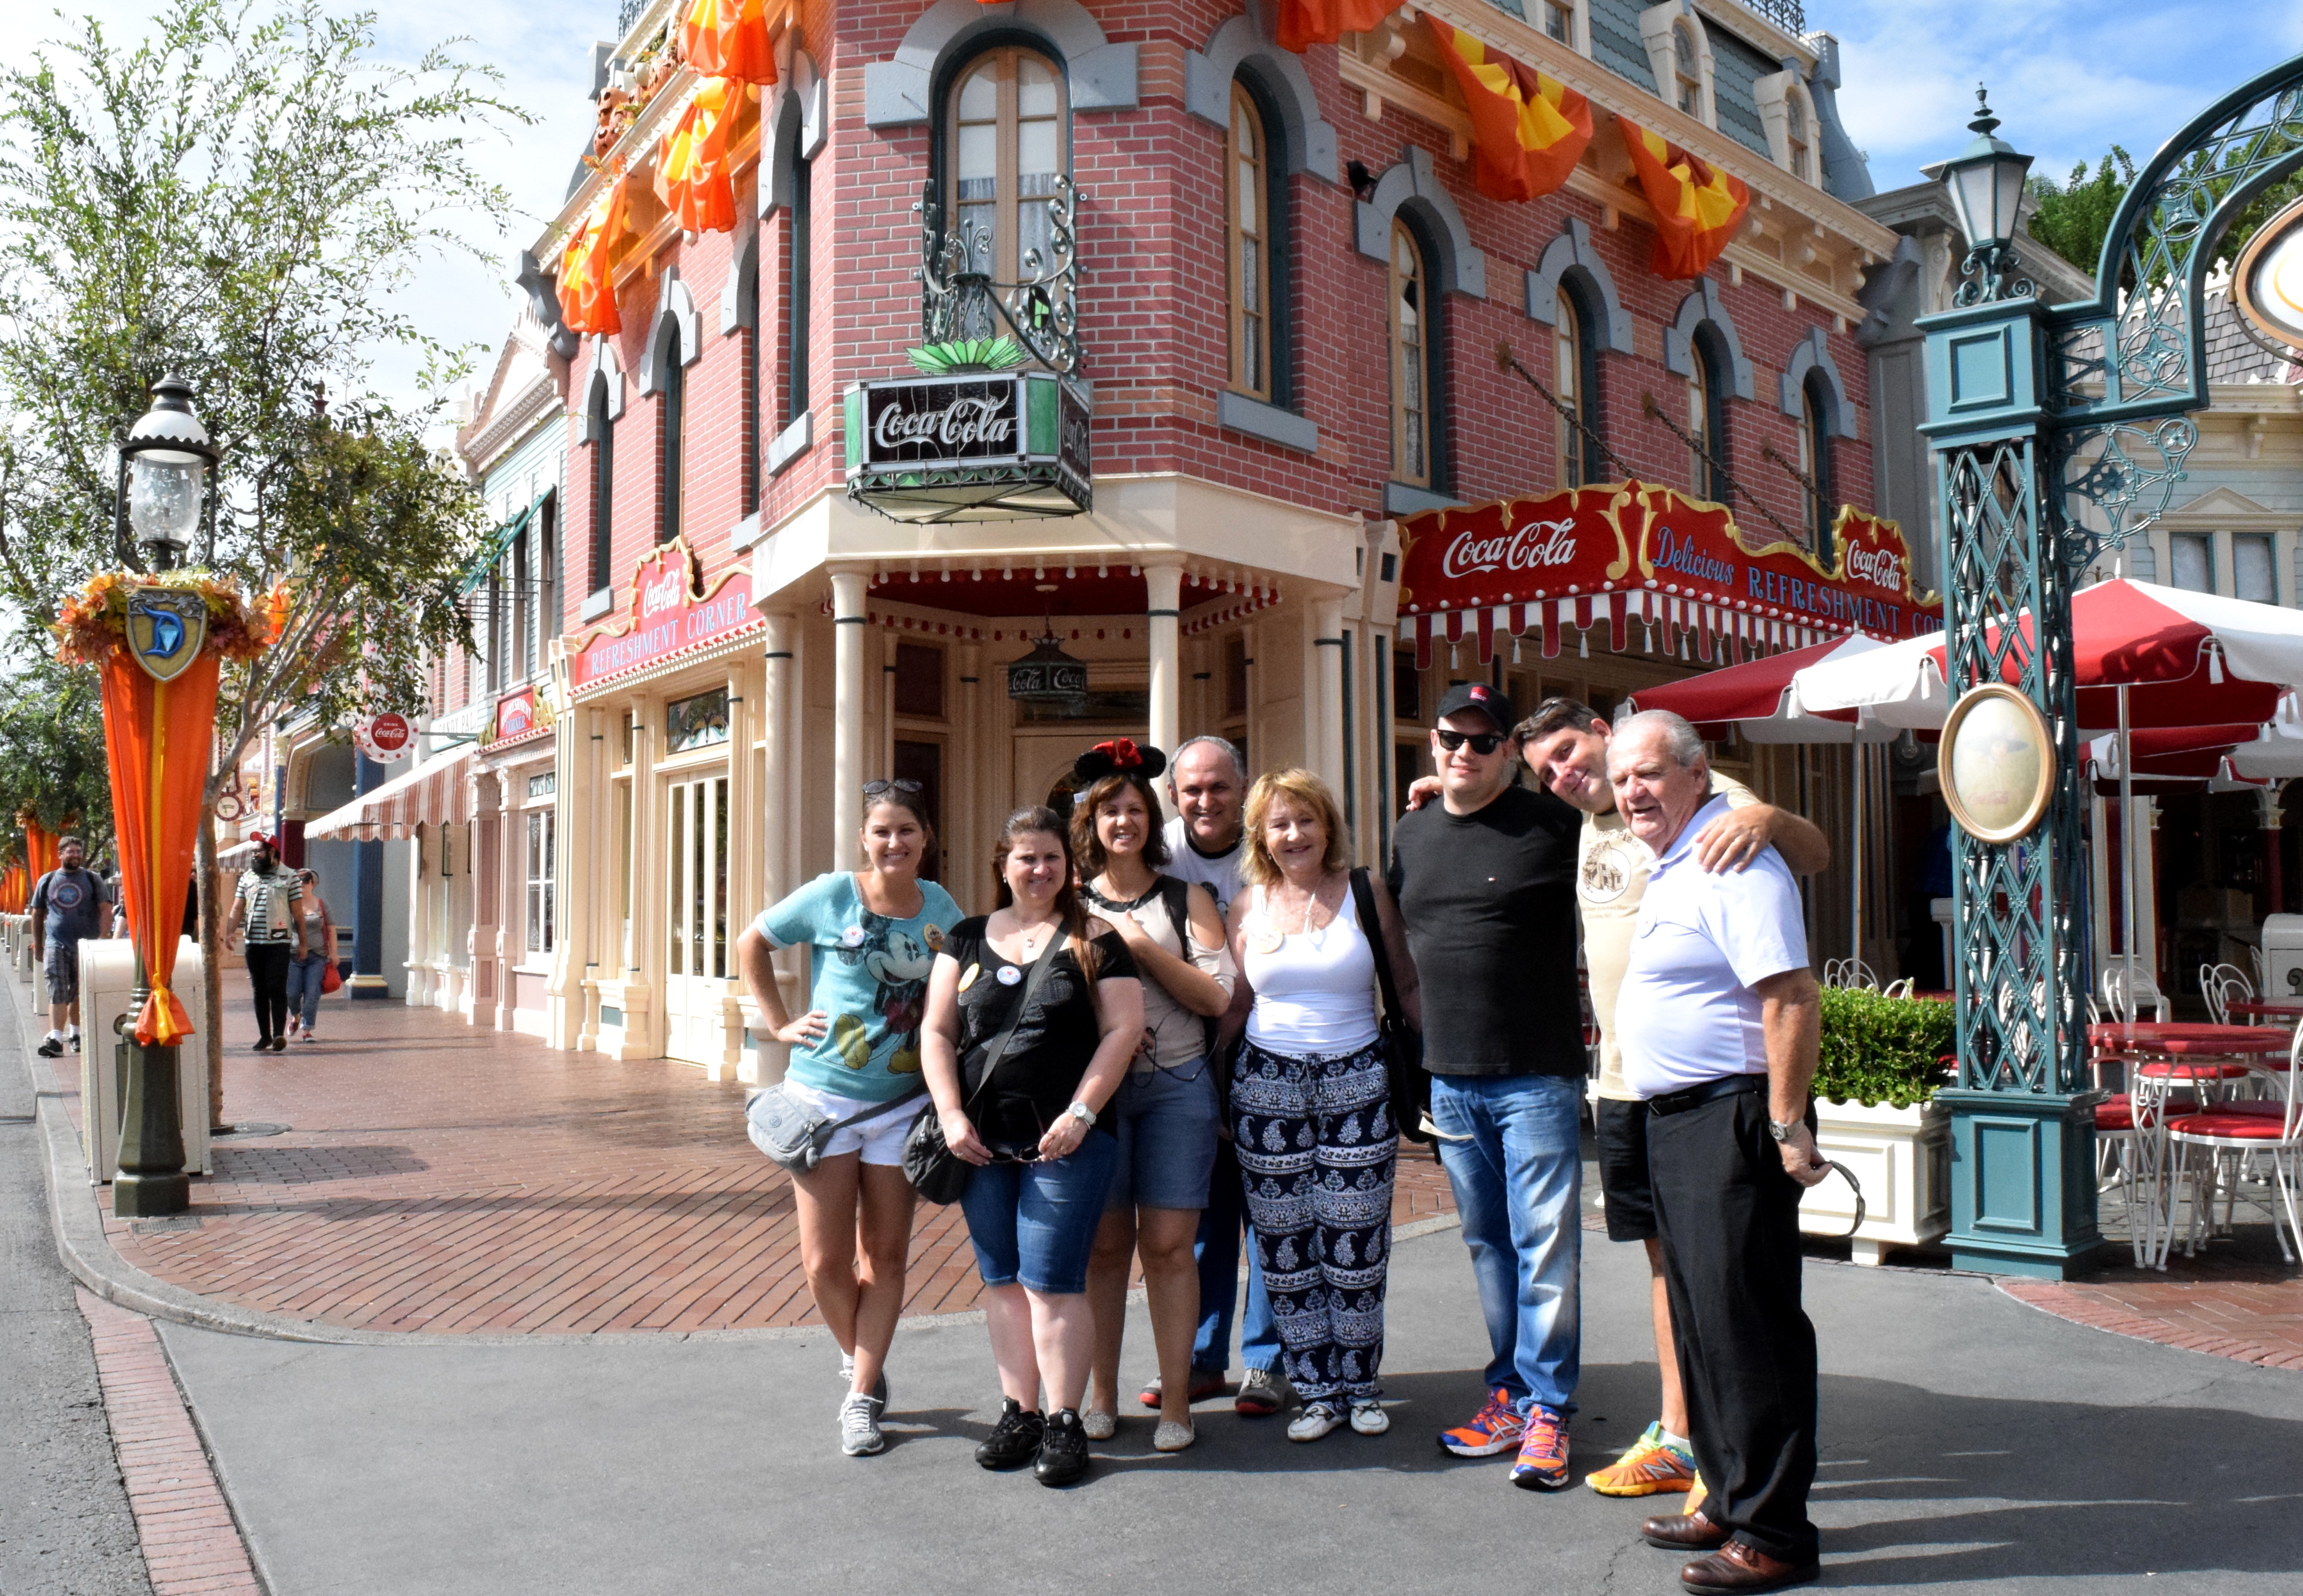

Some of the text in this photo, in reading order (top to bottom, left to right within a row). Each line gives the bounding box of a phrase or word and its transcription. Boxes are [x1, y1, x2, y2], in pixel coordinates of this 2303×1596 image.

[875, 395, 1009, 448] Coca-Cola
[1443, 517, 1576, 578] Coca-Cola
[1846, 539, 1900, 591] Coca-Cola
[643, 568, 681, 619] Coca-Cola
[1652, 525, 1734, 586] Delicious
[1748, 566, 1900, 634] REFRESHMENT
[591, 591, 746, 676] REFRESHMENT CORNER
[375, 727, 406, 738] Coca-Cola
[462, 711, 477, 734] PAL
[500, 698, 532, 731] REFRESHMENT
[506, 715, 526, 734] CORNER
